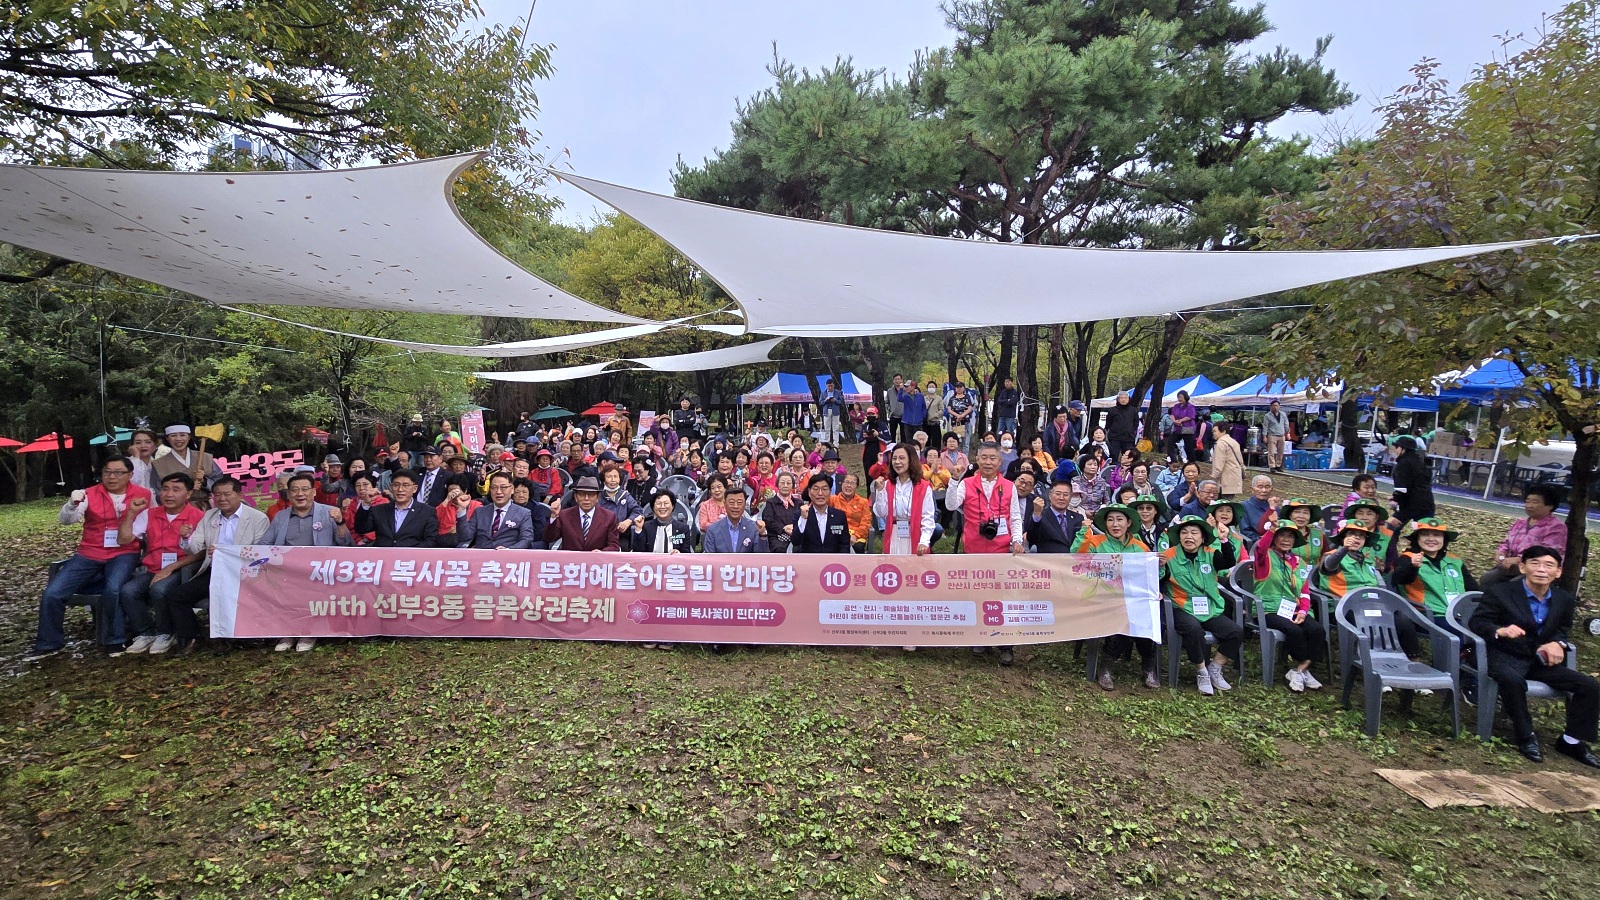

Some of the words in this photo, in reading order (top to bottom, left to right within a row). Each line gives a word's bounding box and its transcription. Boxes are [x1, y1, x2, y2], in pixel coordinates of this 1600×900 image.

[310, 559, 382, 586] 제3회
[390, 560, 471, 588] 복사꽃
[478, 561, 531, 588] 축제
[537, 562, 713, 591] 문화예술어울림
[720, 564, 796, 593] 한마당
[824, 571, 846, 587] 10
[853, 574, 867, 587] 월
[875, 572, 898, 587] 18
[905, 574, 918, 587] 일
[926, 575, 936, 585] 토
[971, 569, 996, 579] 10시
[1007, 568, 1028, 579] 오후
[1031, 569, 1051, 579] 3시
[948, 582, 970, 590] 안산시
[973, 582, 1001, 590] 선부3동
[1022, 582, 1051, 590] 제2공원
[309, 595, 366, 616] with
[373, 594, 465, 620] 선부3동
[471, 595, 615, 623] 골목상권축제
[655, 606, 688, 619] 가을에
[690, 607, 734, 620] 복사꽃이
[736, 608, 776, 620] 핀다면?
